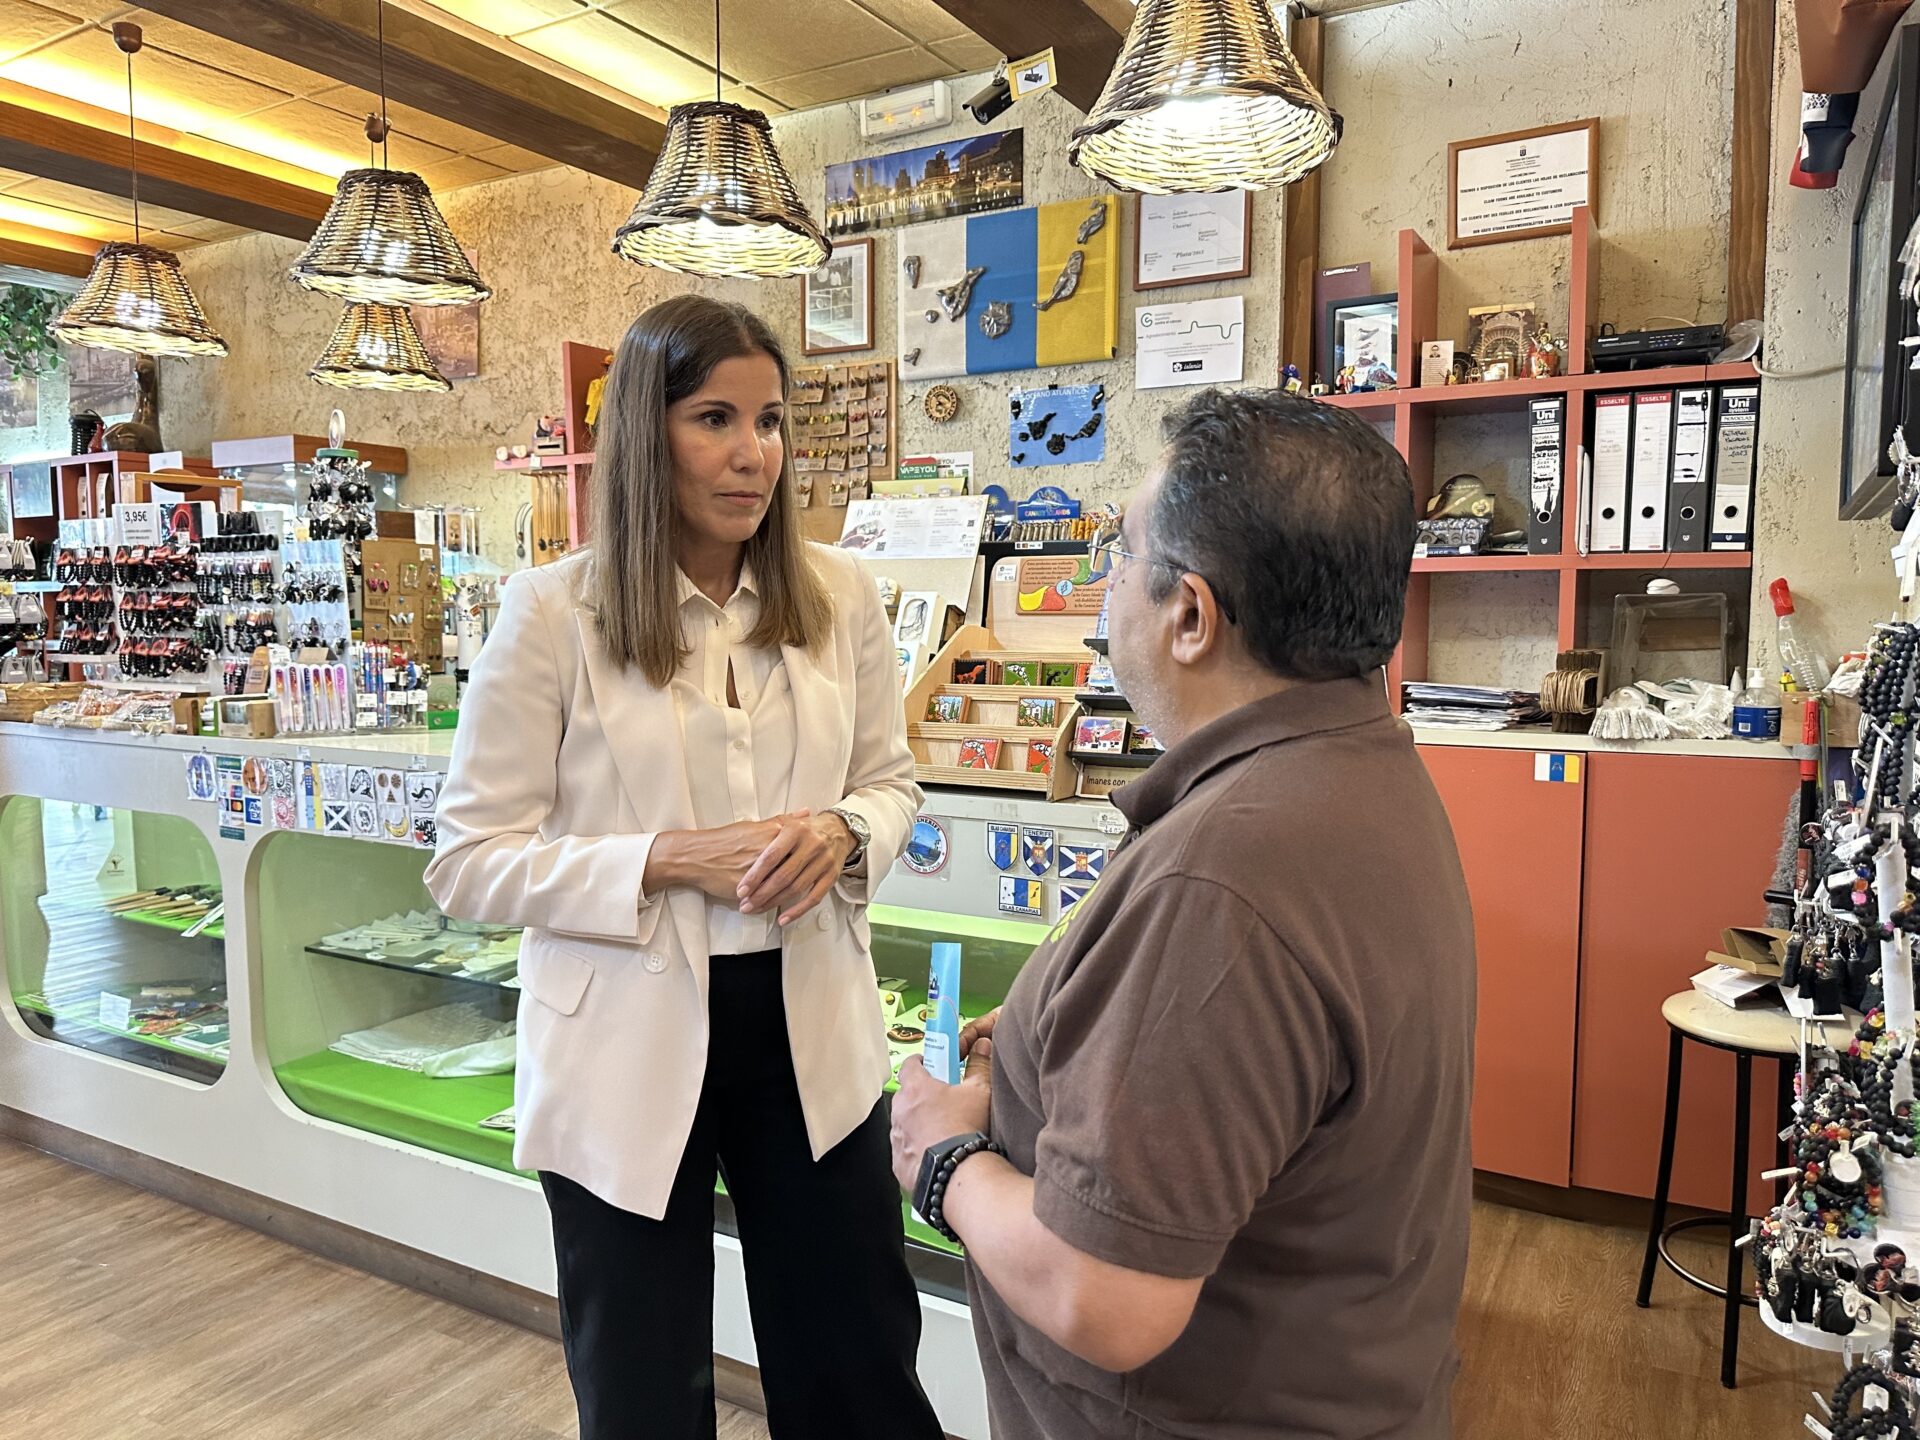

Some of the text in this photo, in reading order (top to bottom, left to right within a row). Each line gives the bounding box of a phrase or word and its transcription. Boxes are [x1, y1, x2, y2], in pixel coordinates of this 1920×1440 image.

[900, 465, 937, 474] VAPEYOU
[125, 511, 147, 524] 3,95€
[1087, 776, 1111, 786] Imanes
